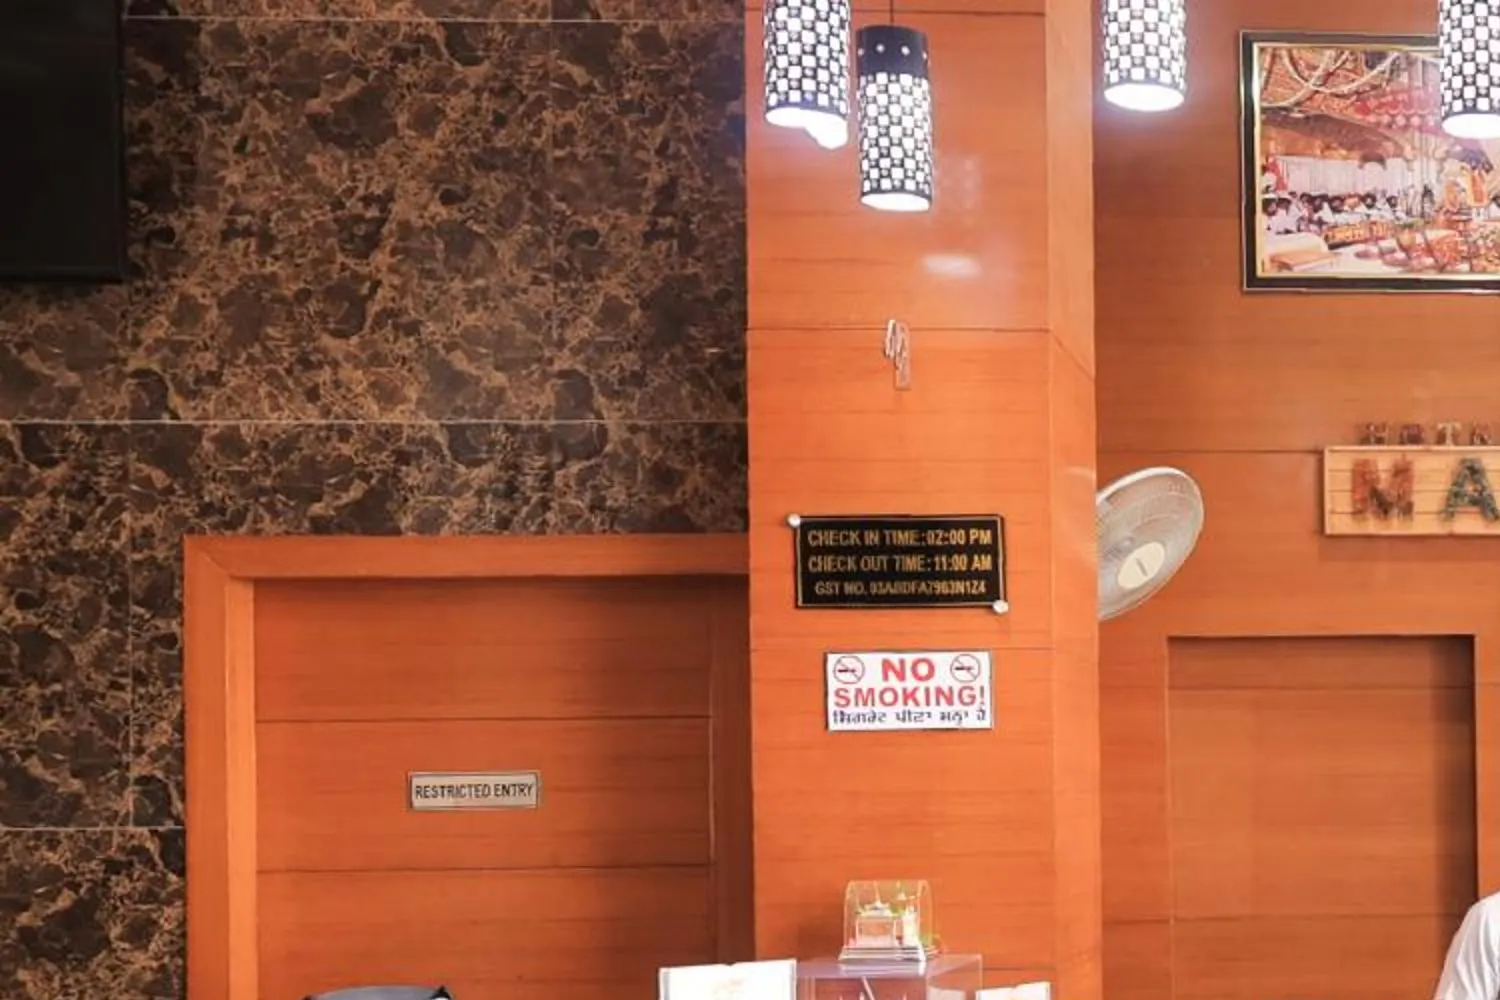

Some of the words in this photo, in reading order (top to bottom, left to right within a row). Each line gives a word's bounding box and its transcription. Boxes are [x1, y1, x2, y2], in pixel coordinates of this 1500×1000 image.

[807, 529, 861, 547] CHECK
[864, 529, 879, 546] IN
[969, 528, 992, 545] PM
[807, 555, 857, 573] CHECK
[860, 555, 888, 572] OUT
[970, 554, 992, 571] AM
[815, 581, 839, 596] GST
[881, 657, 935, 682] NO
[833, 685, 985, 708] SMOKING!
[415, 784, 491, 799] RESTRICTED
[494, 783, 533, 798] ENTRY
